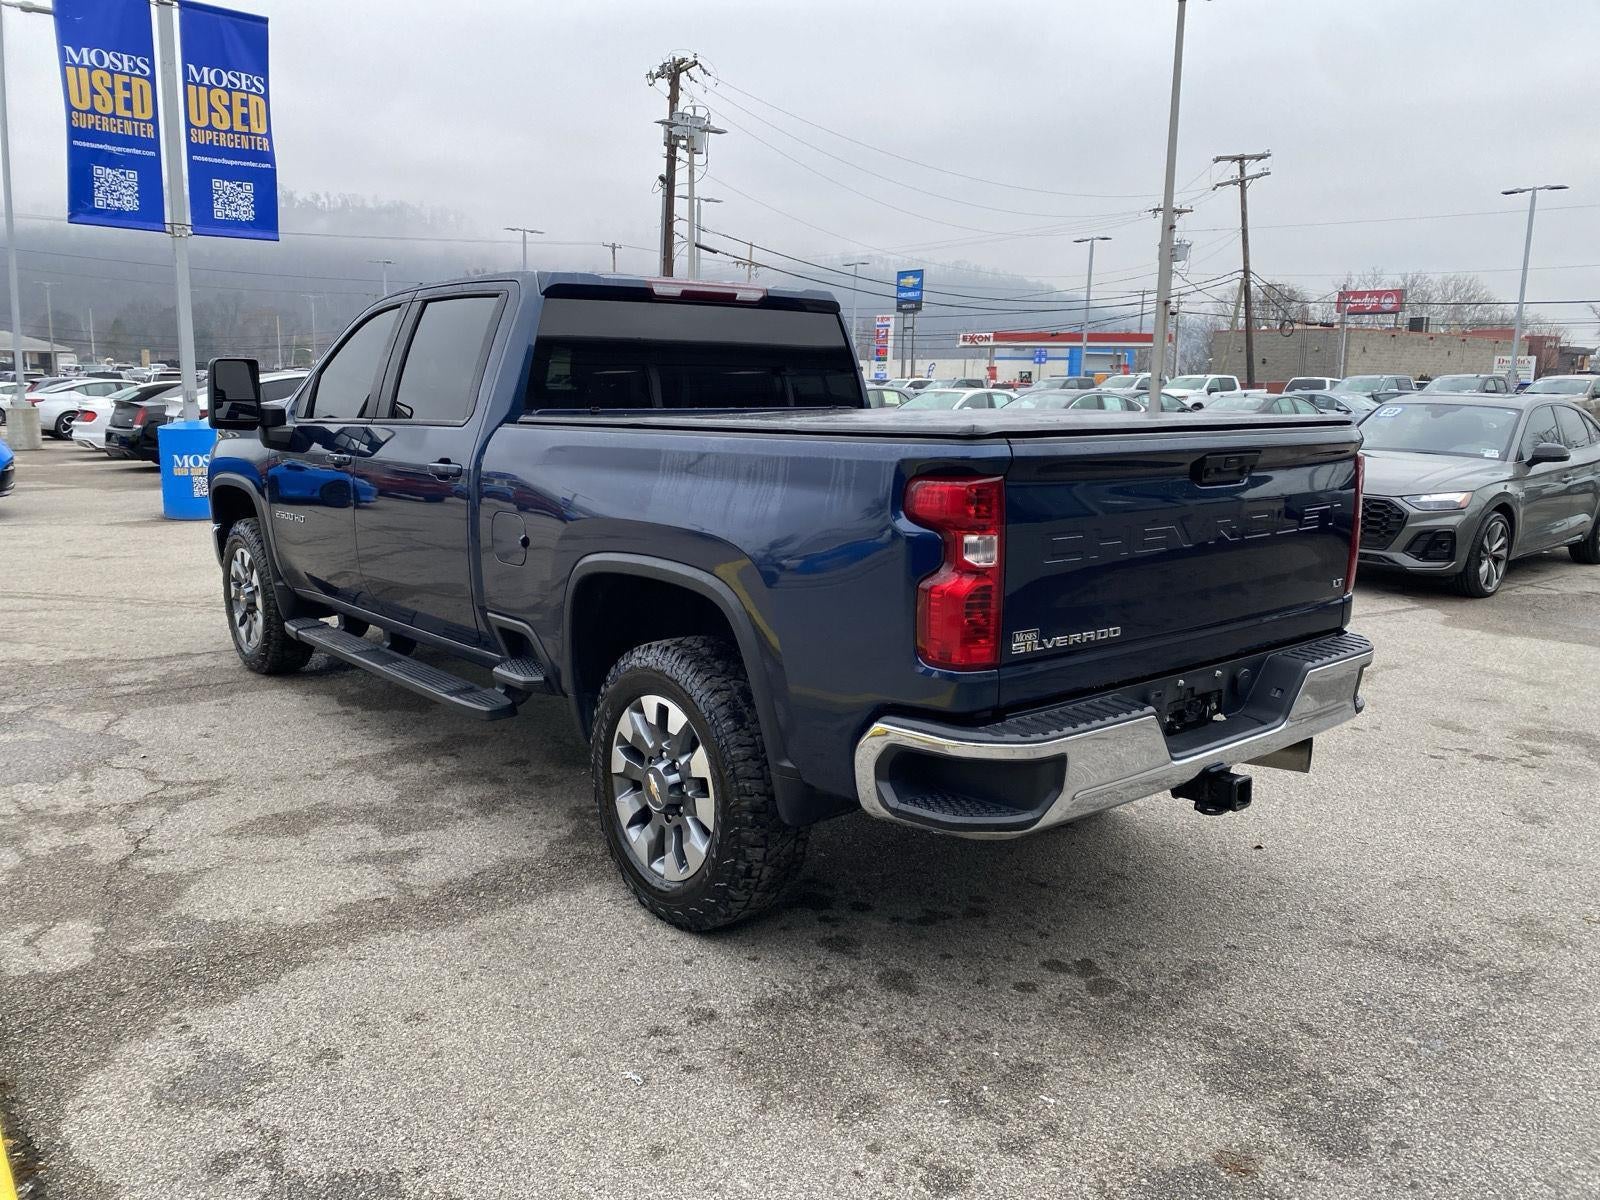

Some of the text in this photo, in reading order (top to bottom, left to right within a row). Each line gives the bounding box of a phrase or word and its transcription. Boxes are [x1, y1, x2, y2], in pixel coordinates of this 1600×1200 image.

[63, 45, 151, 77] MOSES
[65, 66, 154, 120] USED
[186, 63, 265, 95] MOSES
[187, 84, 268, 134] USED
[71, 111, 155, 139] SUPERCENTER
[72, 140, 156, 157] mosesusedsupercenter.com
[190, 128, 270, 152] SUPERCENTER
[192, 155, 272, 169] mosesusedsupercenter.com
[962, 334, 991, 344] EXXON
[172, 454, 211, 468] MOS
[1043, 503, 1343, 565] CHEVROLET
[1333, 578, 1344, 588] LT
[1011, 626, 1121, 655] SILVERADO
